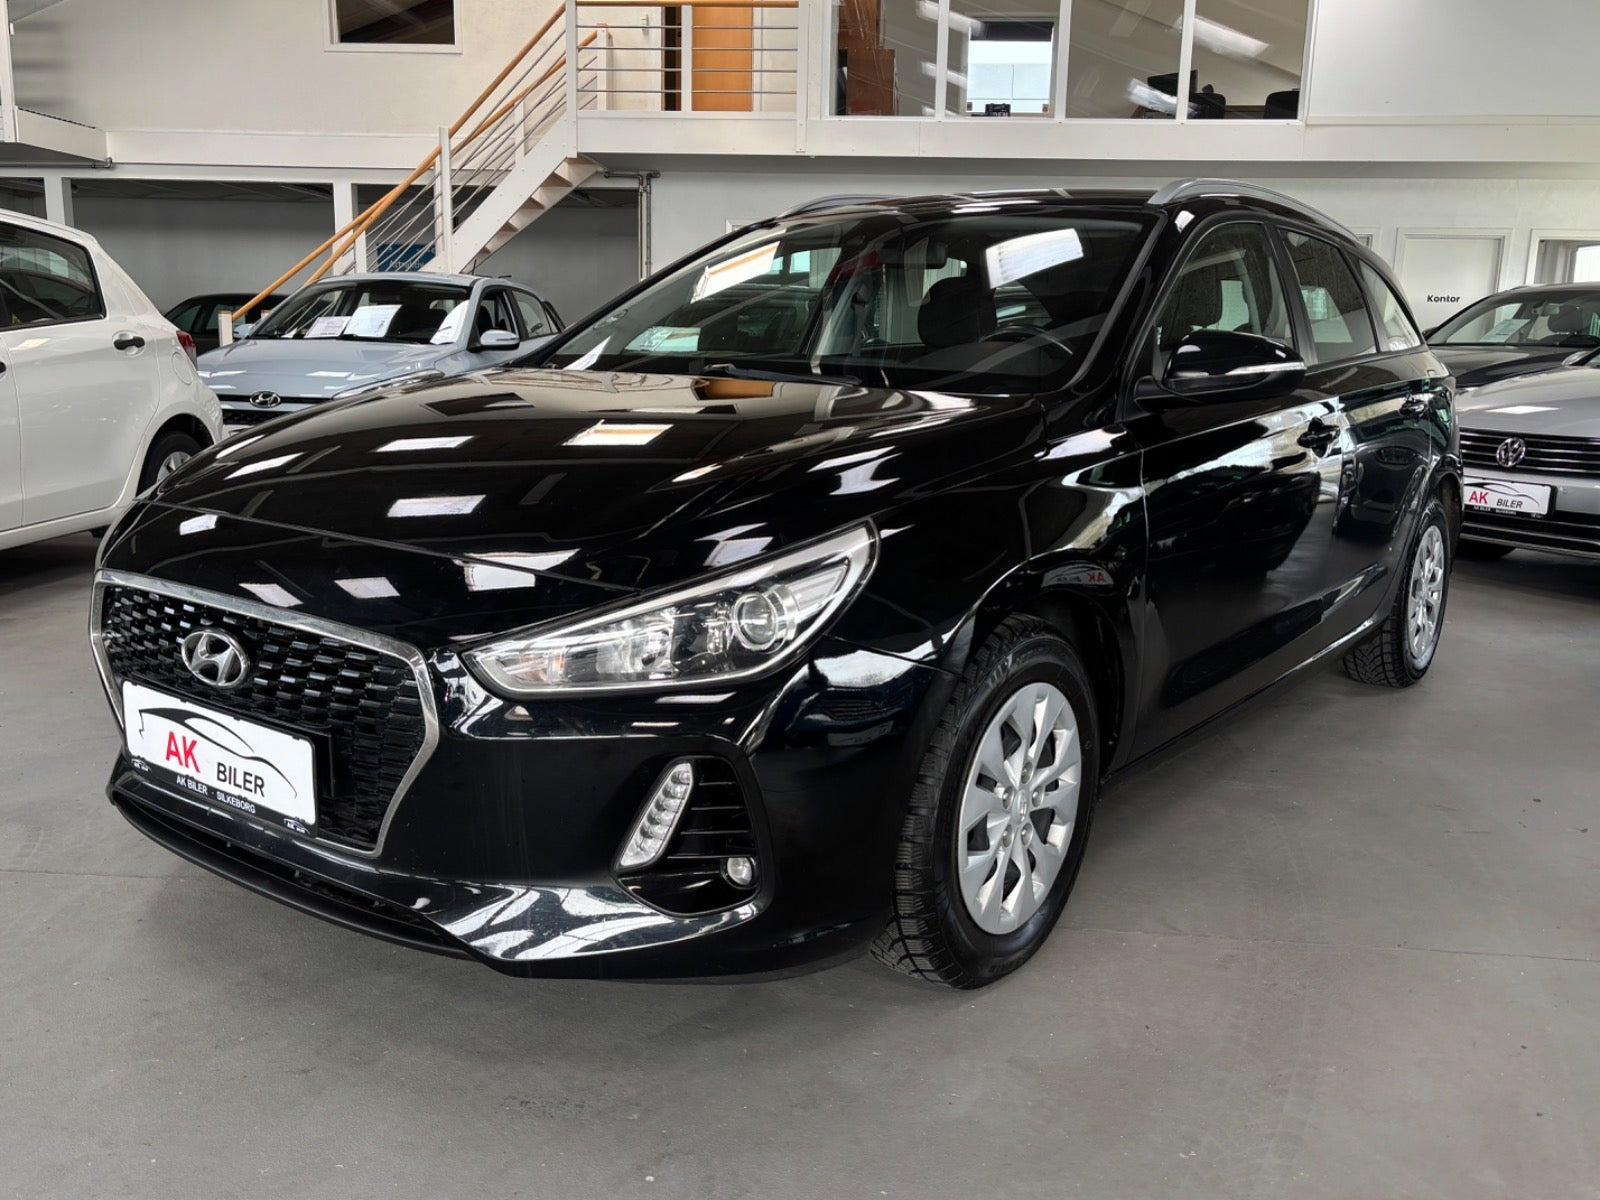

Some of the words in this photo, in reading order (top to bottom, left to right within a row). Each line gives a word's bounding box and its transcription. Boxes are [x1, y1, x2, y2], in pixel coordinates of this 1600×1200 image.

[1426, 294, 1461, 303] Kontor
[1468, 490, 1489, 505] AK
[1496, 498, 1524, 510] BILER
[165, 731, 201, 773] AK
[217, 761, 265, 798] BILER
[176, 775, 187, 787] AK
[187, 779, 208, 795] BILER
[216, 791, 256, 814] SILKEBORG
